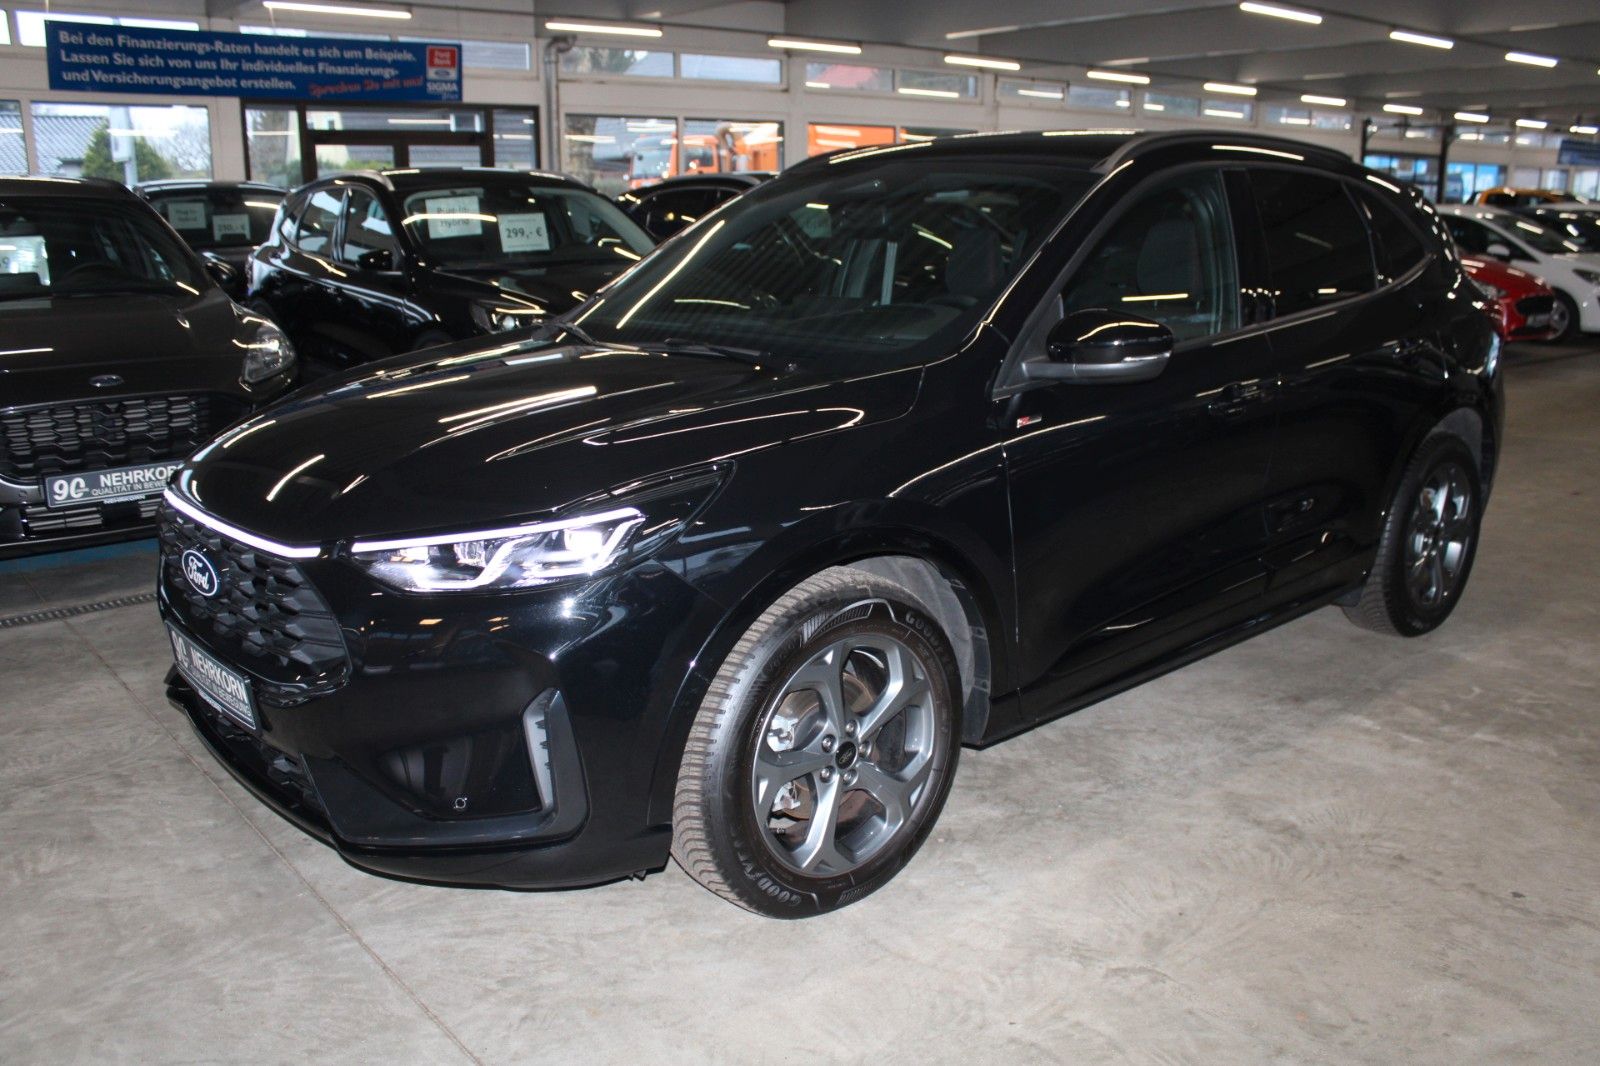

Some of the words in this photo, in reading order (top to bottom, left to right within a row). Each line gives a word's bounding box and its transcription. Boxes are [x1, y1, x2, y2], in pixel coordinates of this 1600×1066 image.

[58, 31, 83, 45] Bei
[87, 33, 114, 47] den
[117, 34, 251, 55] Finanzierungs-Raten
[254, 43, 300, 57] handelt
[302, 47, 316, 58] es
[318, 46, 341, 60] sich
[343, 49, 362, 60] um
[365, 48, 417, 63] Beispiele.
[60, 51, 110, 65] Lassen
[113, 52, 135, 66] Sie
[138, 54, 164, 68] sich
[168, 57, 192, 69] von
[194, 58, 217, 70] uns
[220, 58, 238, 71] Ihr
[241, 59, 316, 75] individuelles
[318, 62, 399, 79] Finanzierungs-
[62, 69, 90, 82] und
[91, 69, 238, 89] Versicherungsangebot
[240, 77, 296, 90] erstellen.
[133, 481, 143, 491] IN
[144, 479, 167, 490] BEWE
[187, 555, 210, 590] Ford
[190, 646, 249, 704] NEHRKORN
